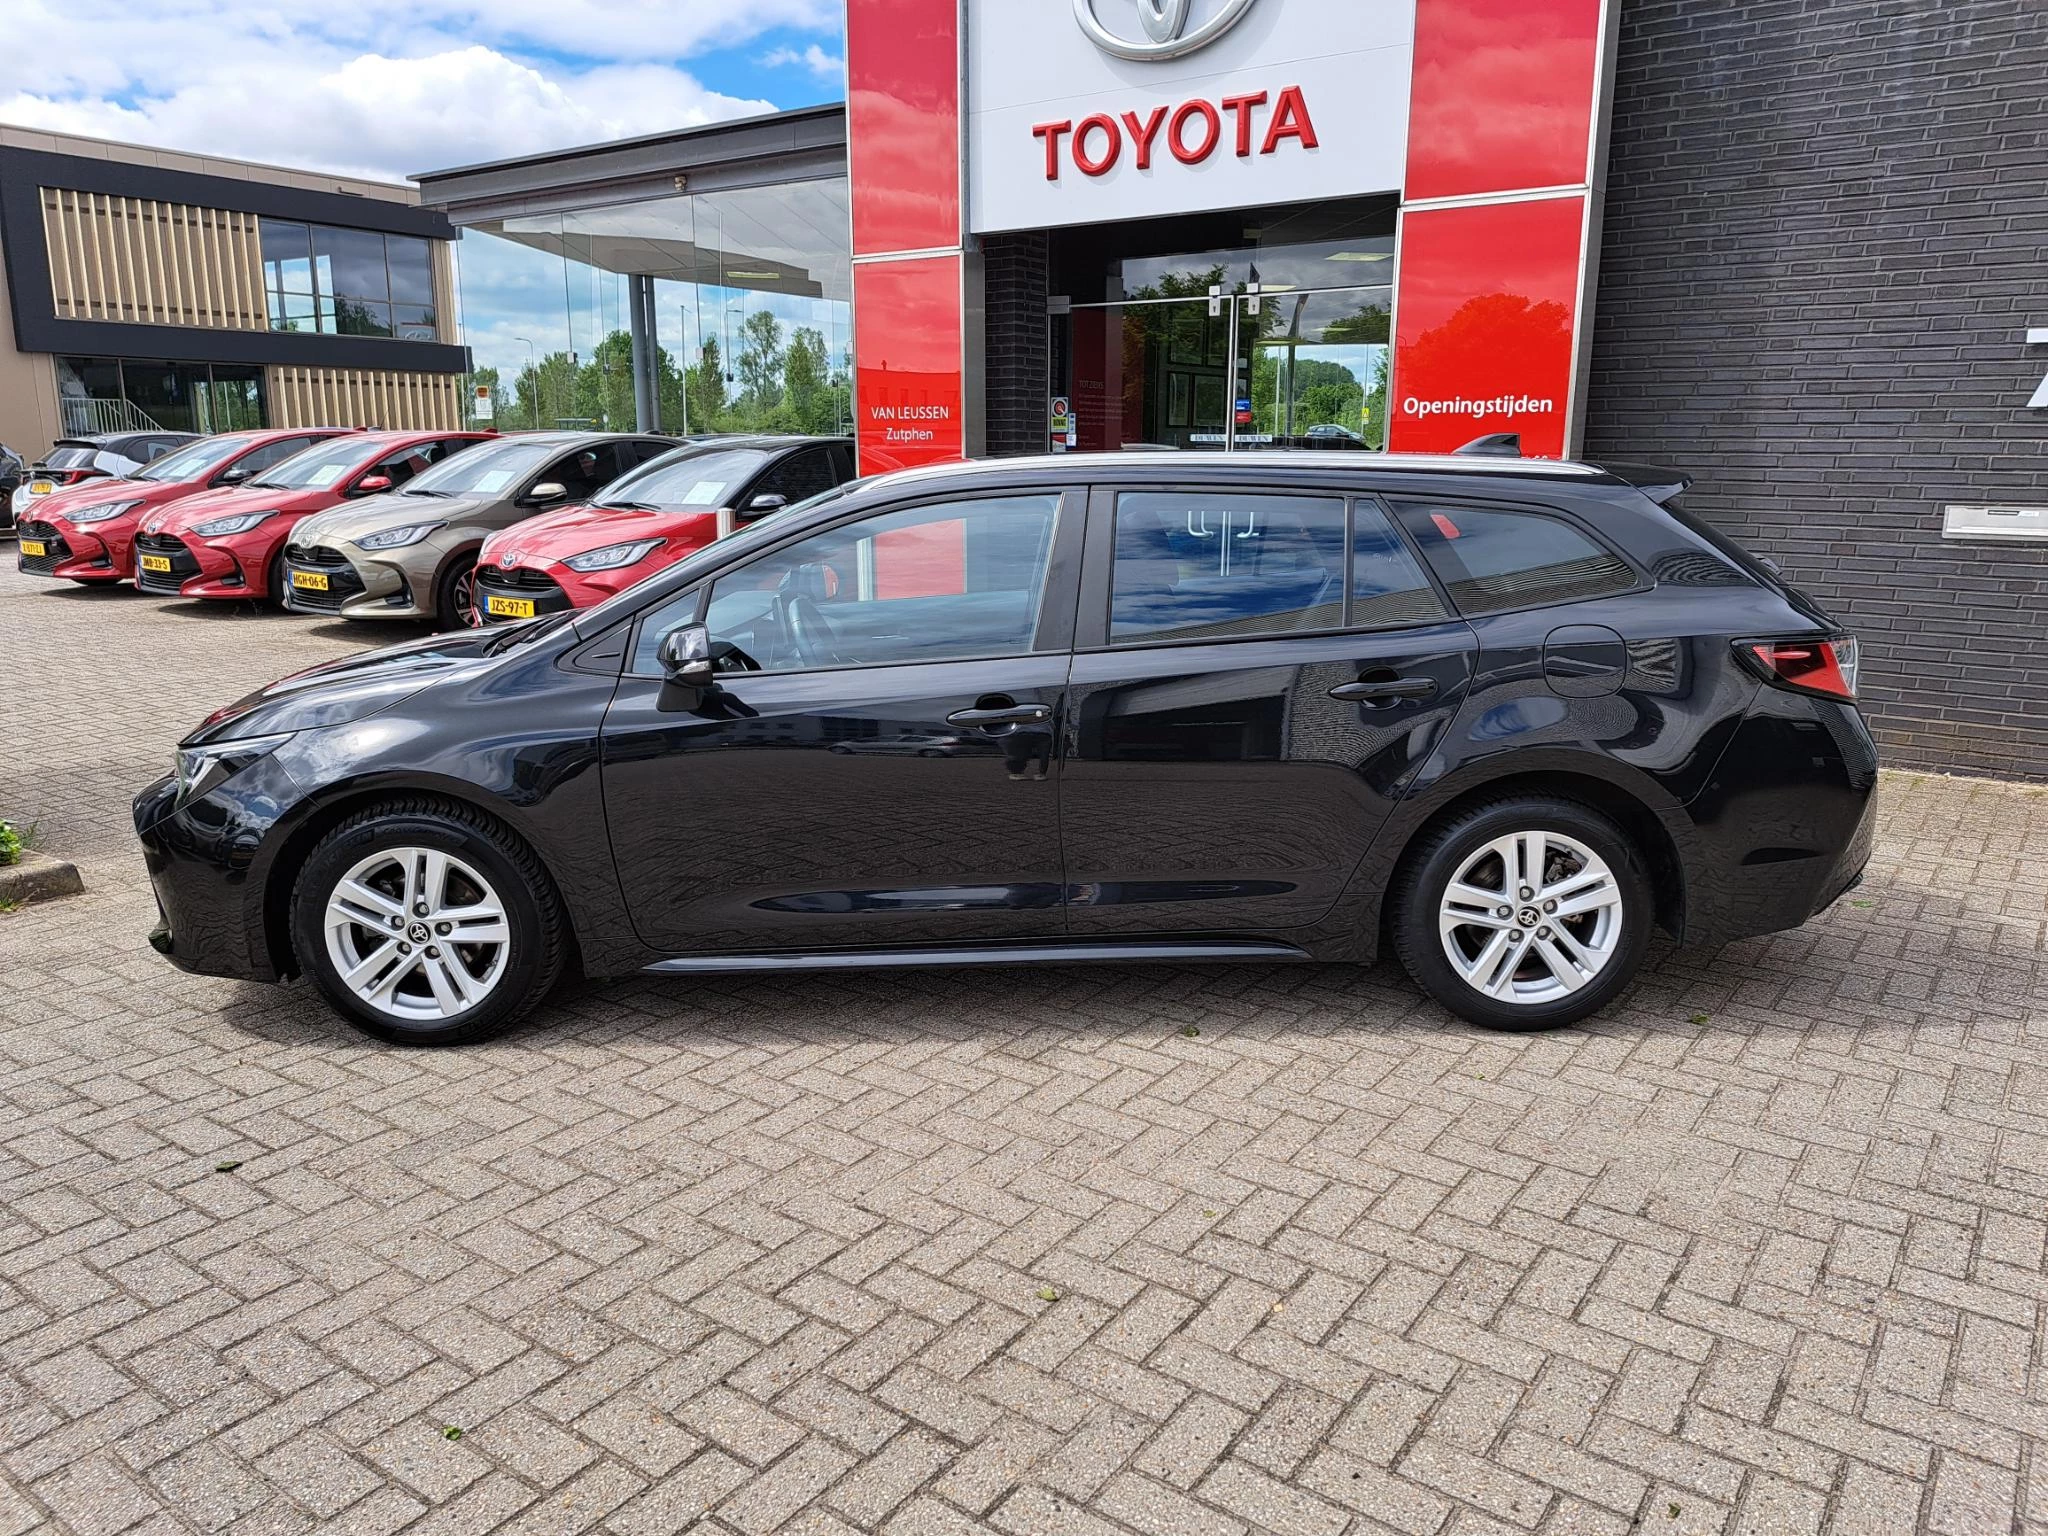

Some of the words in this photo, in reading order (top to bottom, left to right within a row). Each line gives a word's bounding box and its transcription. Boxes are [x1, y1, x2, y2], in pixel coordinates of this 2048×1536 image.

[1032, 85, 1319, 181] TOYOTA
[871, 406, 895, 419] VAN
[898, 406, 949, 419] LEUSSEN
[1403, 394, 1552, 419] Openingstijden
[886, 427, 933, 443] Zutphen
[293, 574, 327, 588] HGH-06-G
[492, 599, 528, 615] JZS-97-T
